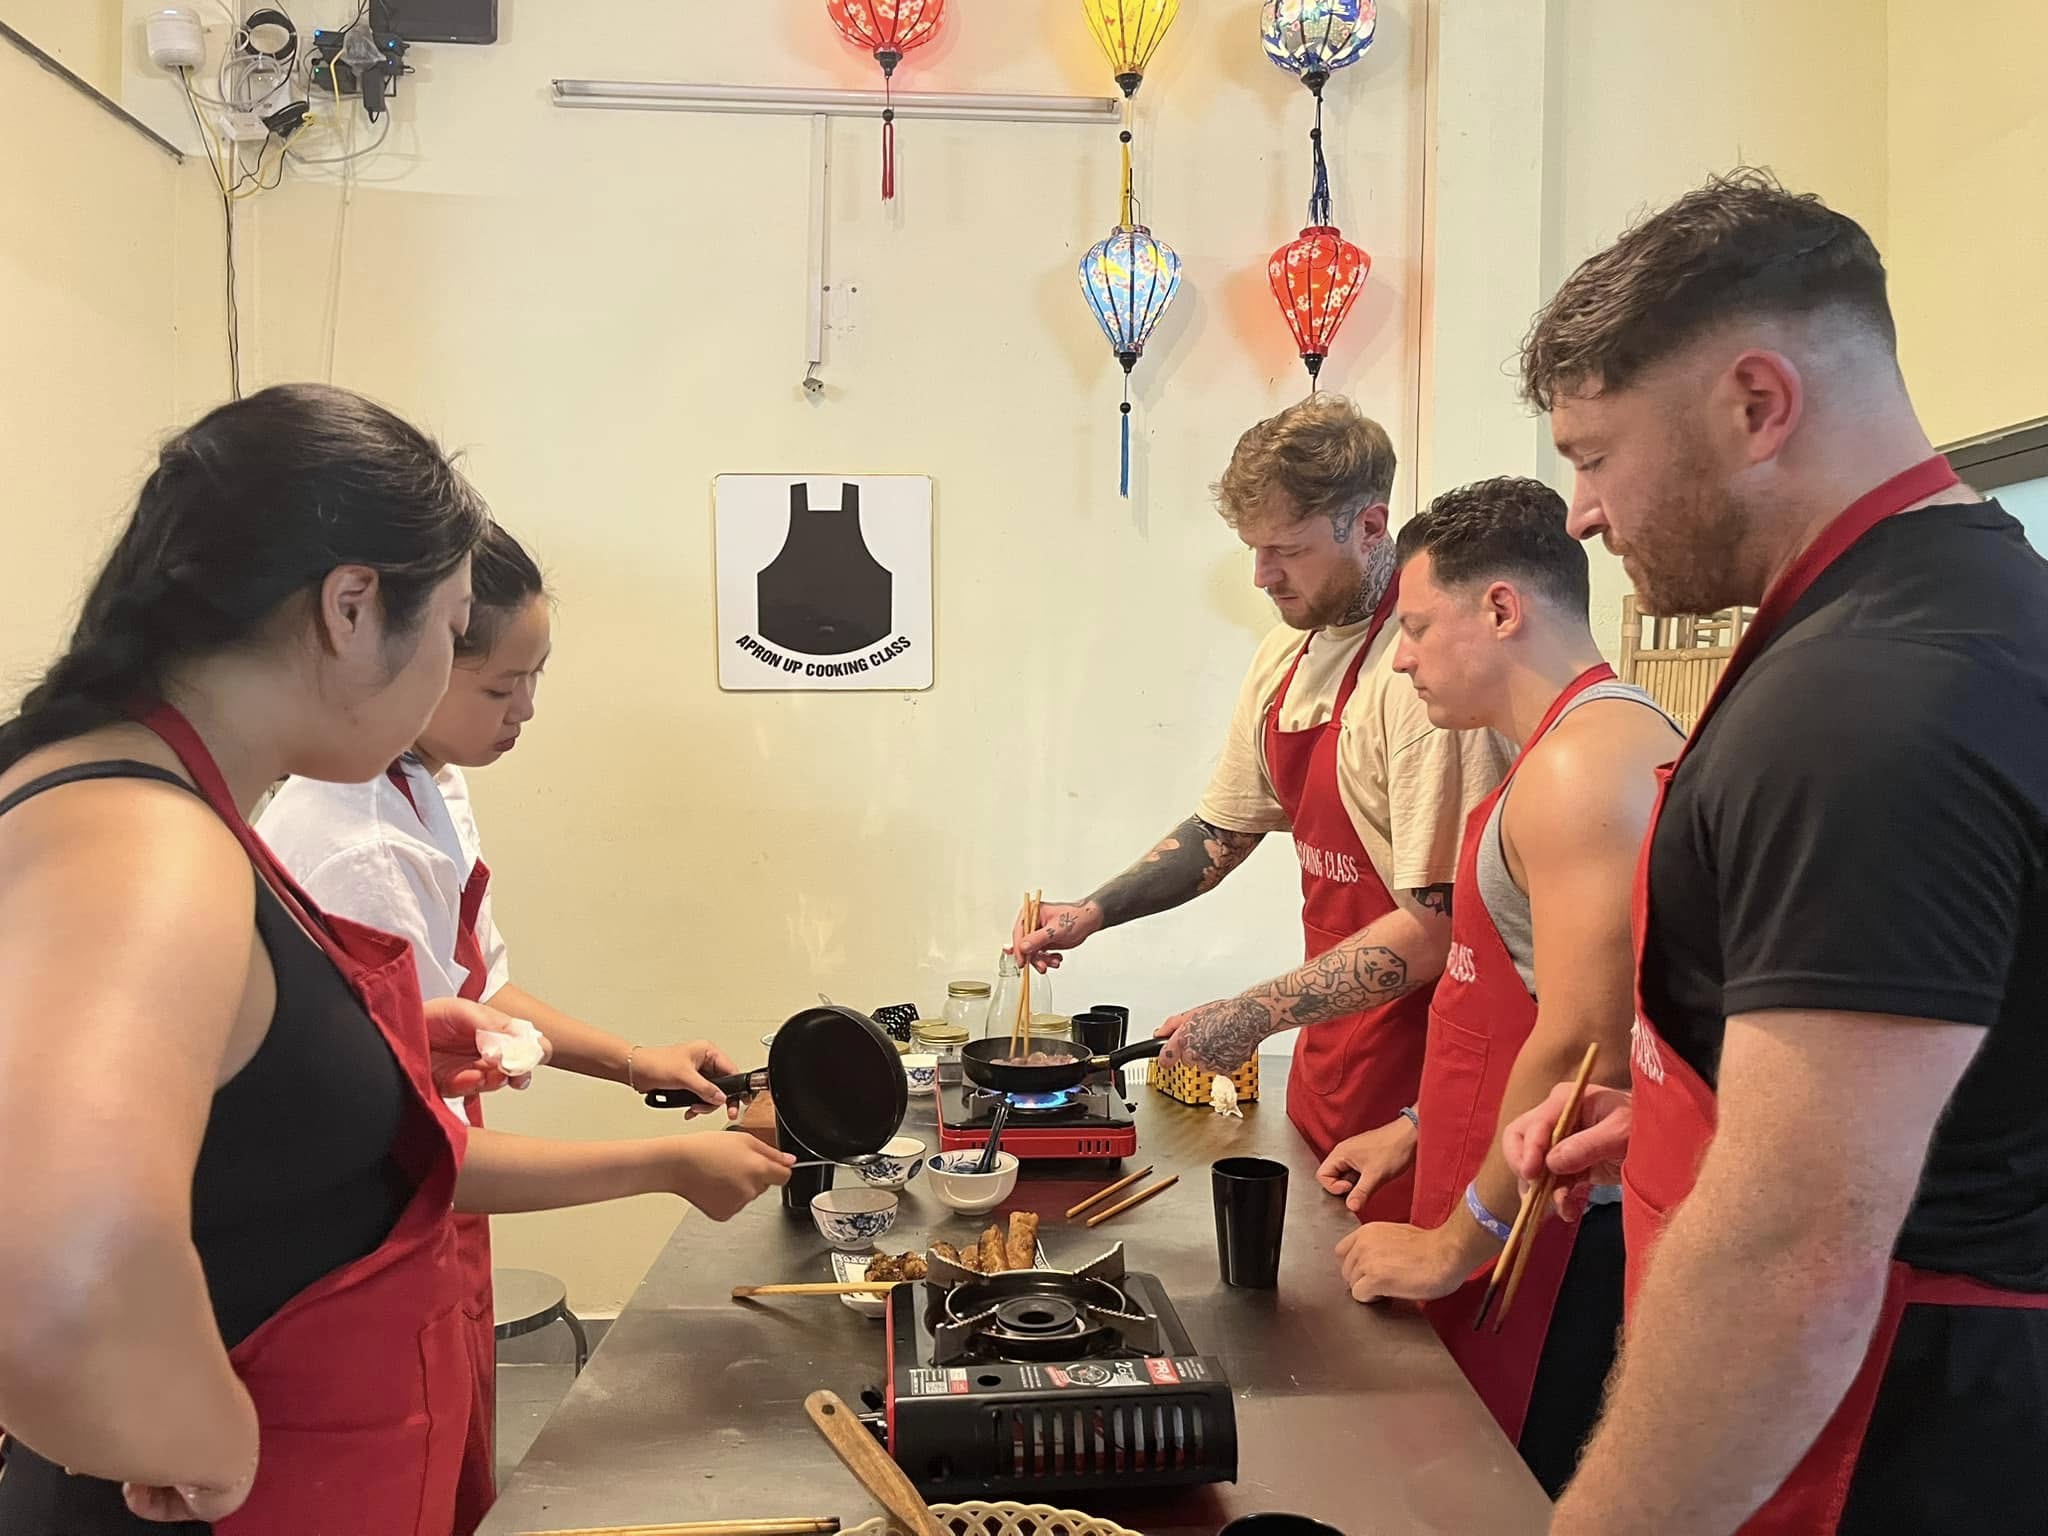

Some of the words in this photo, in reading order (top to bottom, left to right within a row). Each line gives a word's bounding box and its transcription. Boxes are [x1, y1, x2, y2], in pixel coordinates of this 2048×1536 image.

[735, 634, 783, 668] APRON
[783, 658, 803, 674] UP
[805, 658, 869, 678] COOKING
[869, 635, 912, 667] CLASS
[1324, 849, 1359, 883] CLASS
